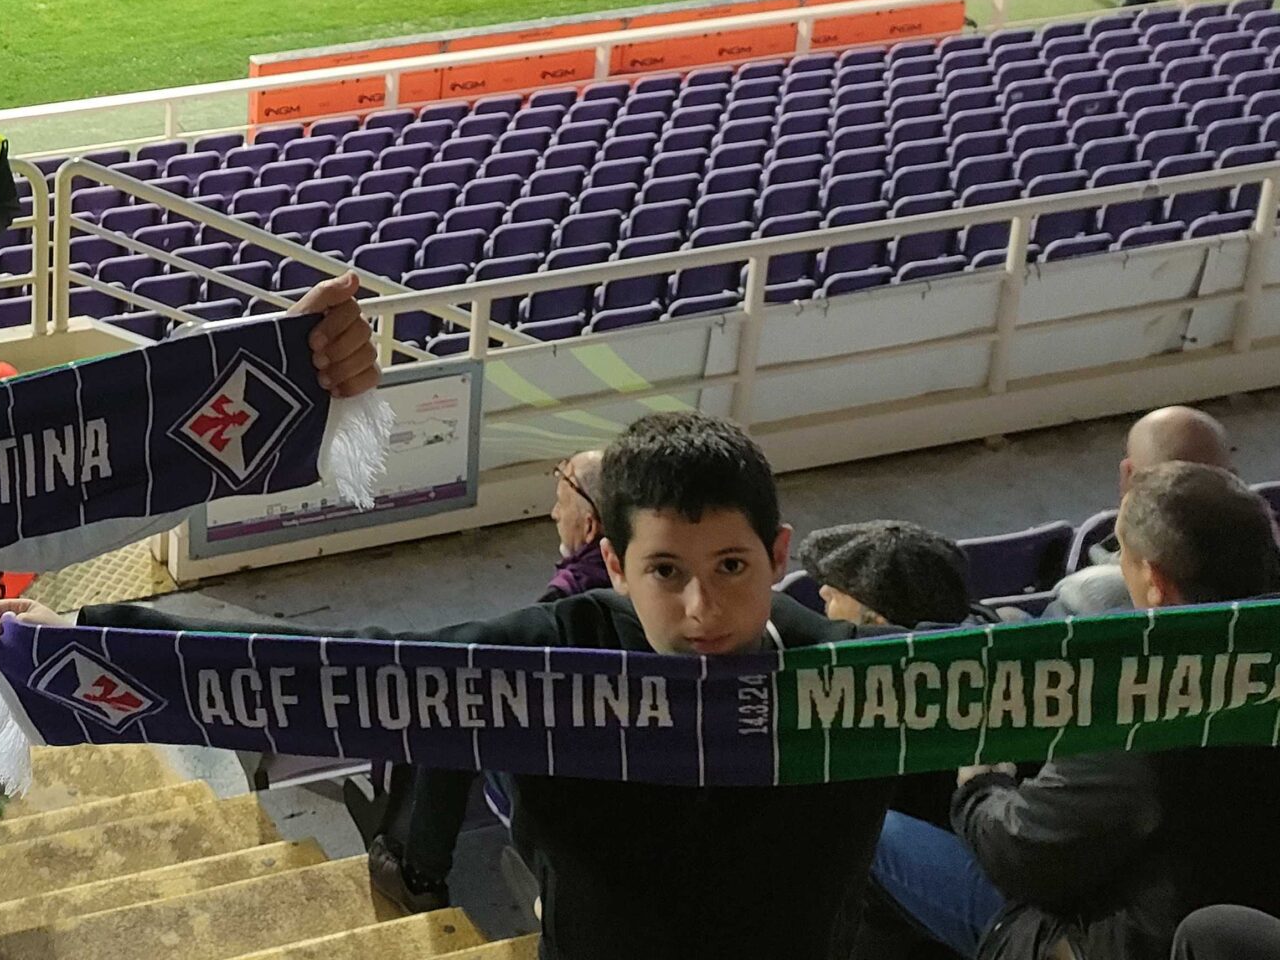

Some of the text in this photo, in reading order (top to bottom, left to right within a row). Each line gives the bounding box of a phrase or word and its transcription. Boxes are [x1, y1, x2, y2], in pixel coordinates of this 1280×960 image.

[358, 93, 385, 104] NG
[198, 665, 673, 728] ACF FIORENTINA
[795, 658, 1095, 730] MACCABI
